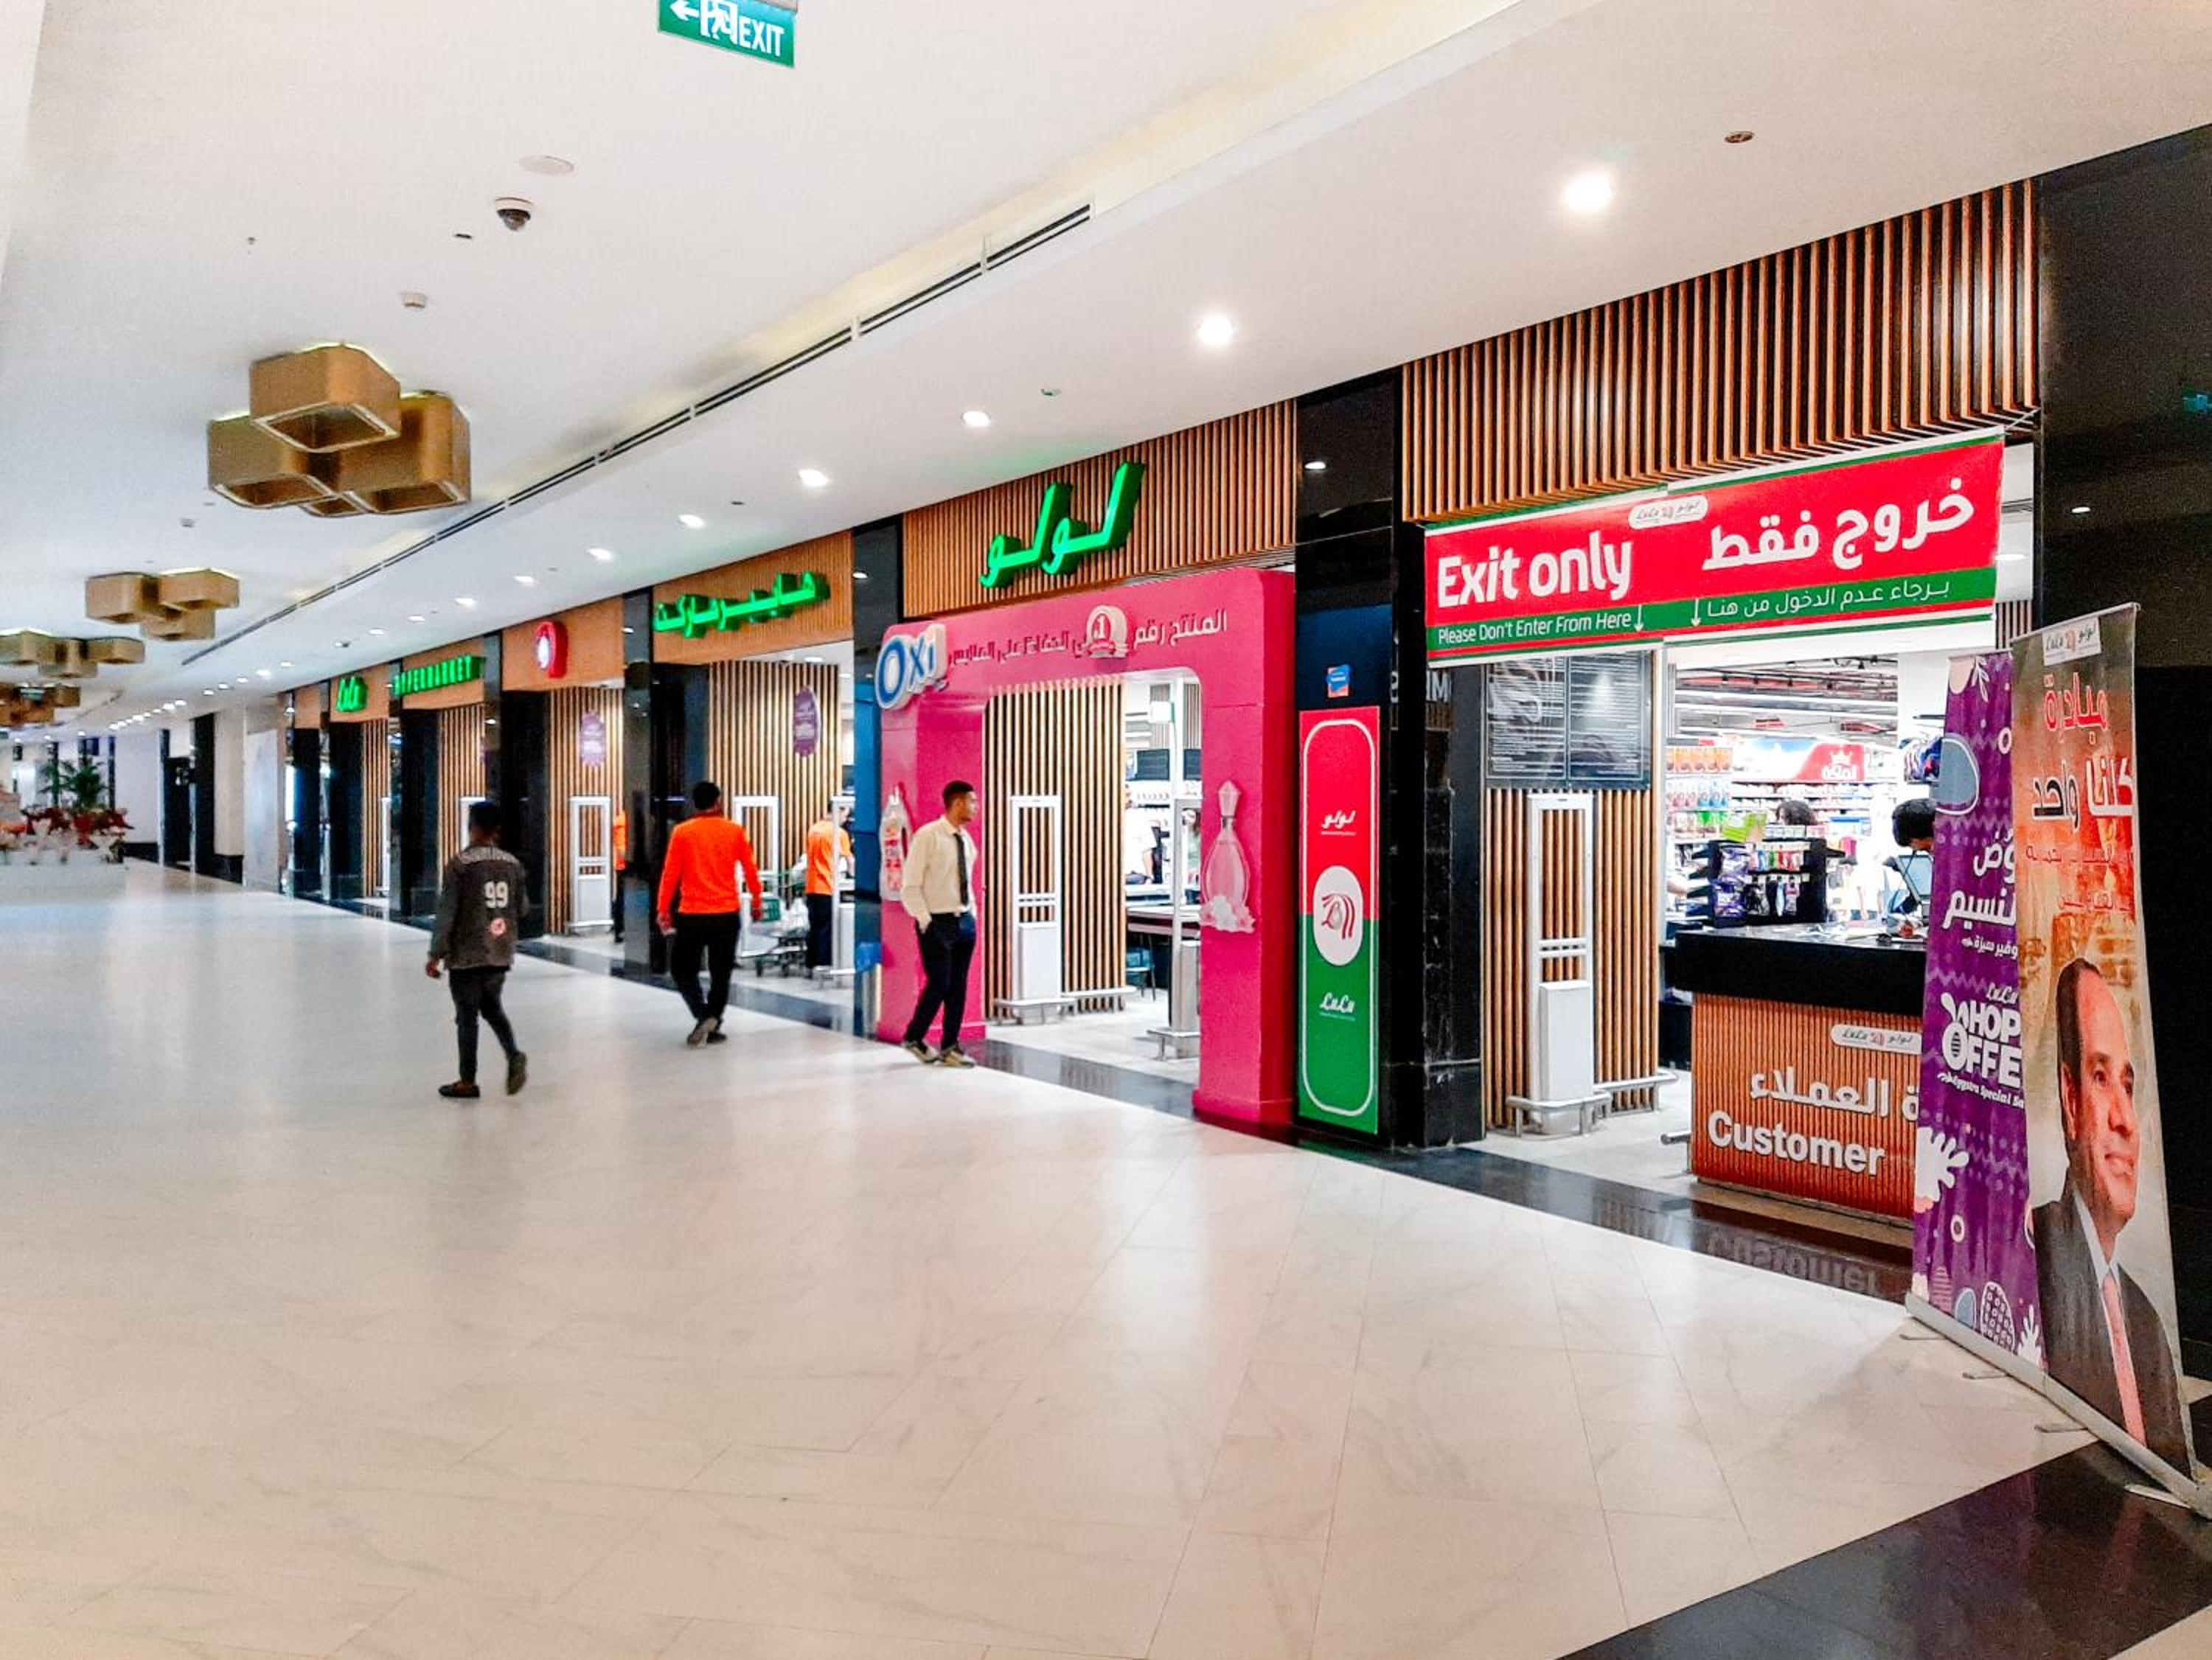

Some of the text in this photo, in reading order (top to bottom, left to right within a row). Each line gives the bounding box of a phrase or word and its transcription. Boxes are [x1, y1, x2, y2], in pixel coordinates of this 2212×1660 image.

[739, 15, 785, 57] EXIT
[979, 461, 1141, 588] لولو
[1702, 477, 1975, 571] خروج فقط
[1439, 530, 1632, 608] Exit only
[1708, 600, 1739, 618] هنا
[1744, 599, 1770, 618] من
[1775, 588, 1835, 614] الدخول
[1840, 588, 1884, 611] عدم
[1134, 619, 1166, 649] رقم
[1169, 610, 1227, 647] المنتج
[1439, 611, 1632, 645] Please Don't Enter From Here
[2044, 672, 2108, 744] مبادرة
[2033, 761, 2081, 831] واحد
[1321, 810, 1357, 829] لولو
[484, 881, 509, 909] 99
[1319, 991, 1355, 1014] LuLu
[1942, 1022, 2022, 1089] OFFE
[1750, 1066, 1889, 1118] العملاء
[1708, 1110, 1885, 1176] Customer
